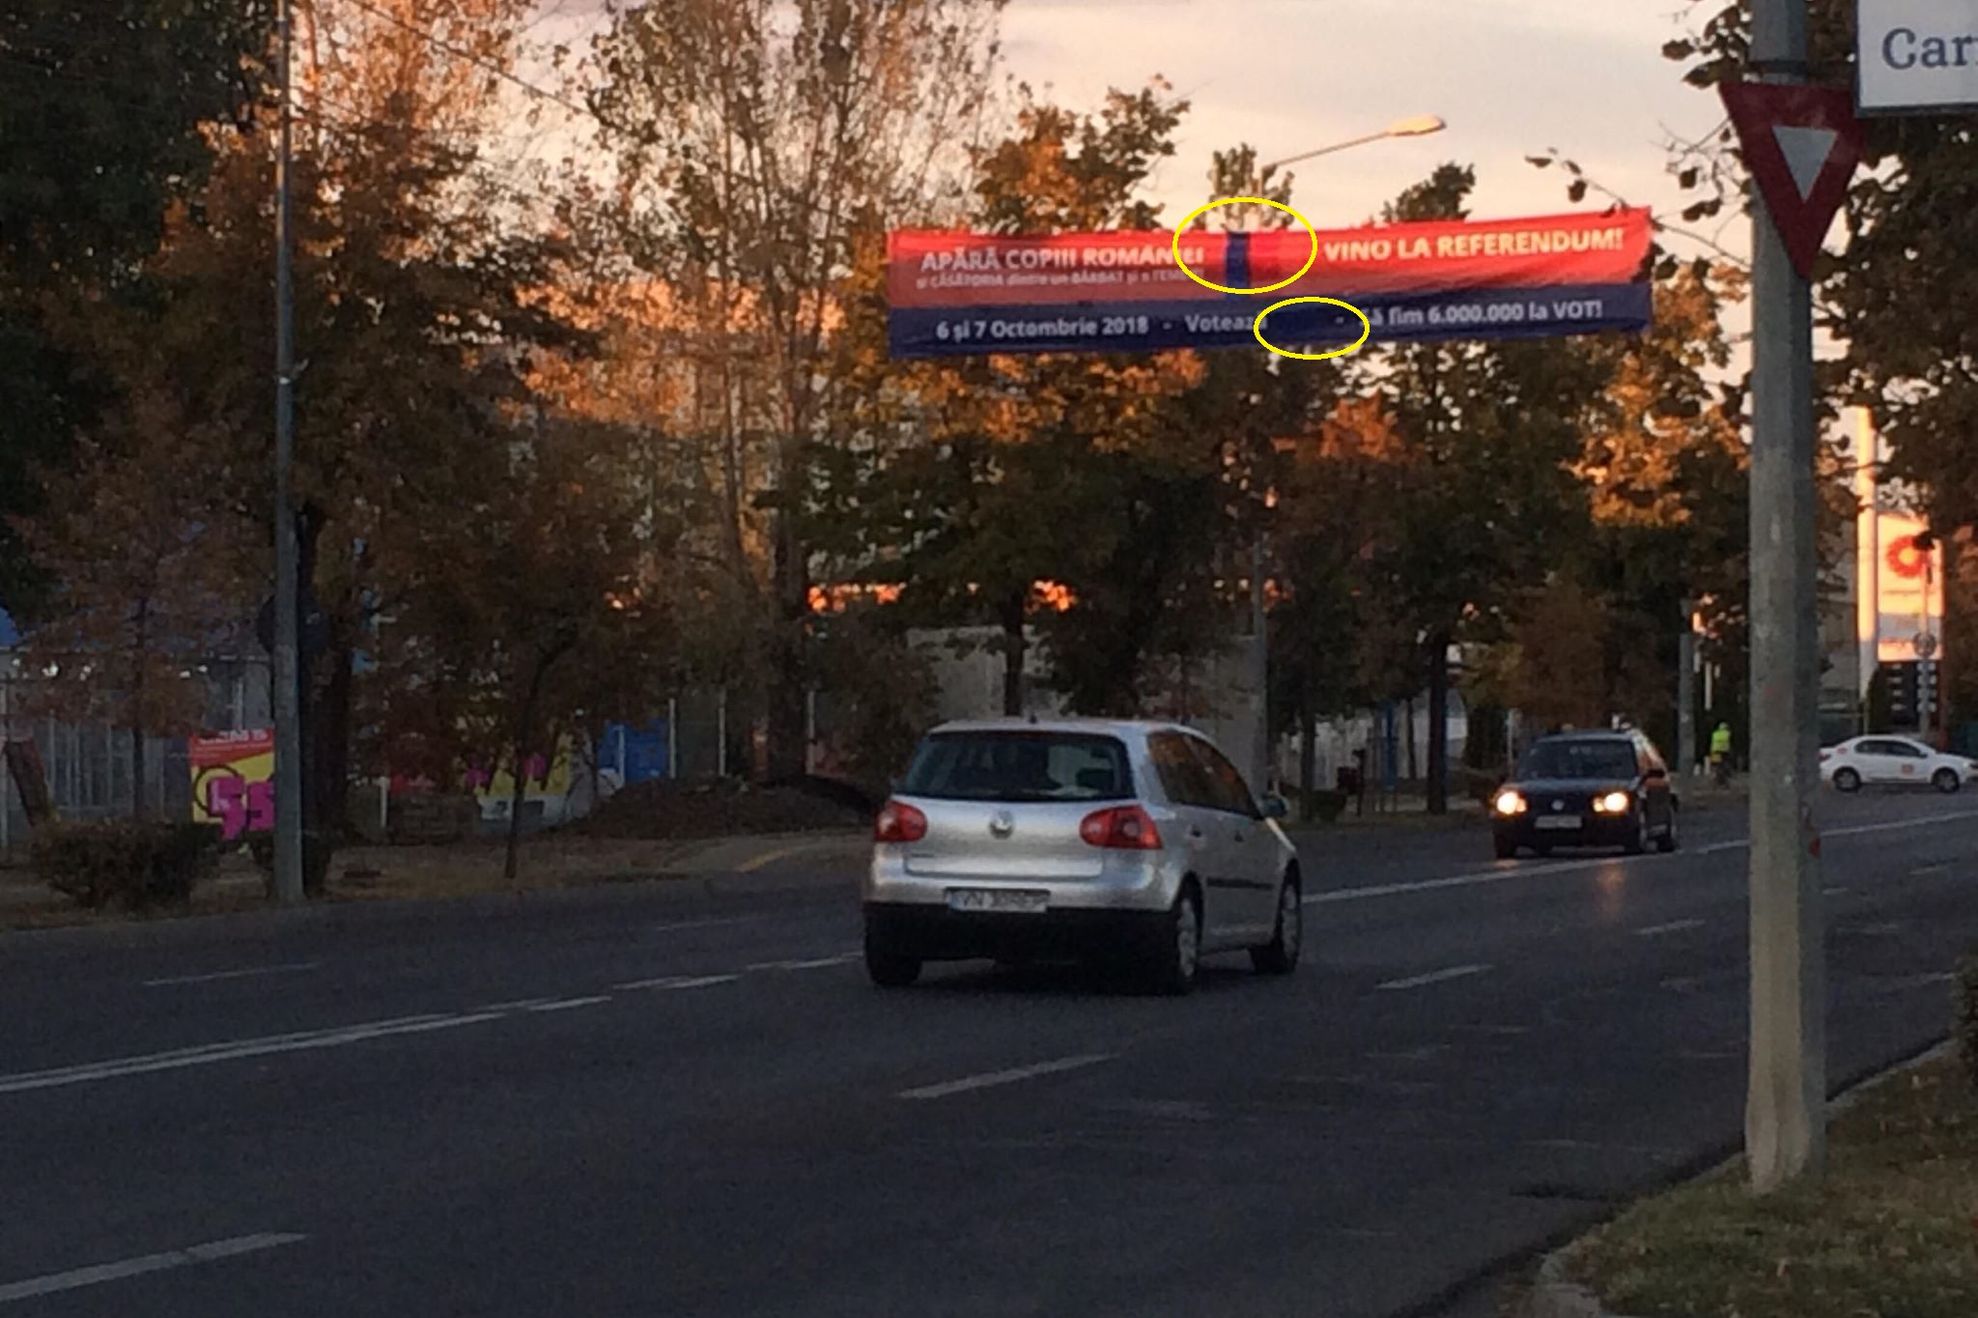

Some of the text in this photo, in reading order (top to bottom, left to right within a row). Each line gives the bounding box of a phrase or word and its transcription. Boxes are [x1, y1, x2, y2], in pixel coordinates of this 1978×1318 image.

[1882, 27, 1978, 70] Car
[920, 246, 1001, 272] APĂRĂ
[1005, 248, 1077, 269] COPIII
[1324, 227, 1624, 262] VINO LA REFERENDUM!
[936, 320, 950, 339] 6
[974, 320, 987, 338] 7
[990, 317, 1098, 338] Octombrie
[1102, 315, 1149, 335] 2018
[1389, 306, 1424, 326] fim
[1428, 303, 1525, 325] 6.000.000
[1528, 301, 1548, 320] la
